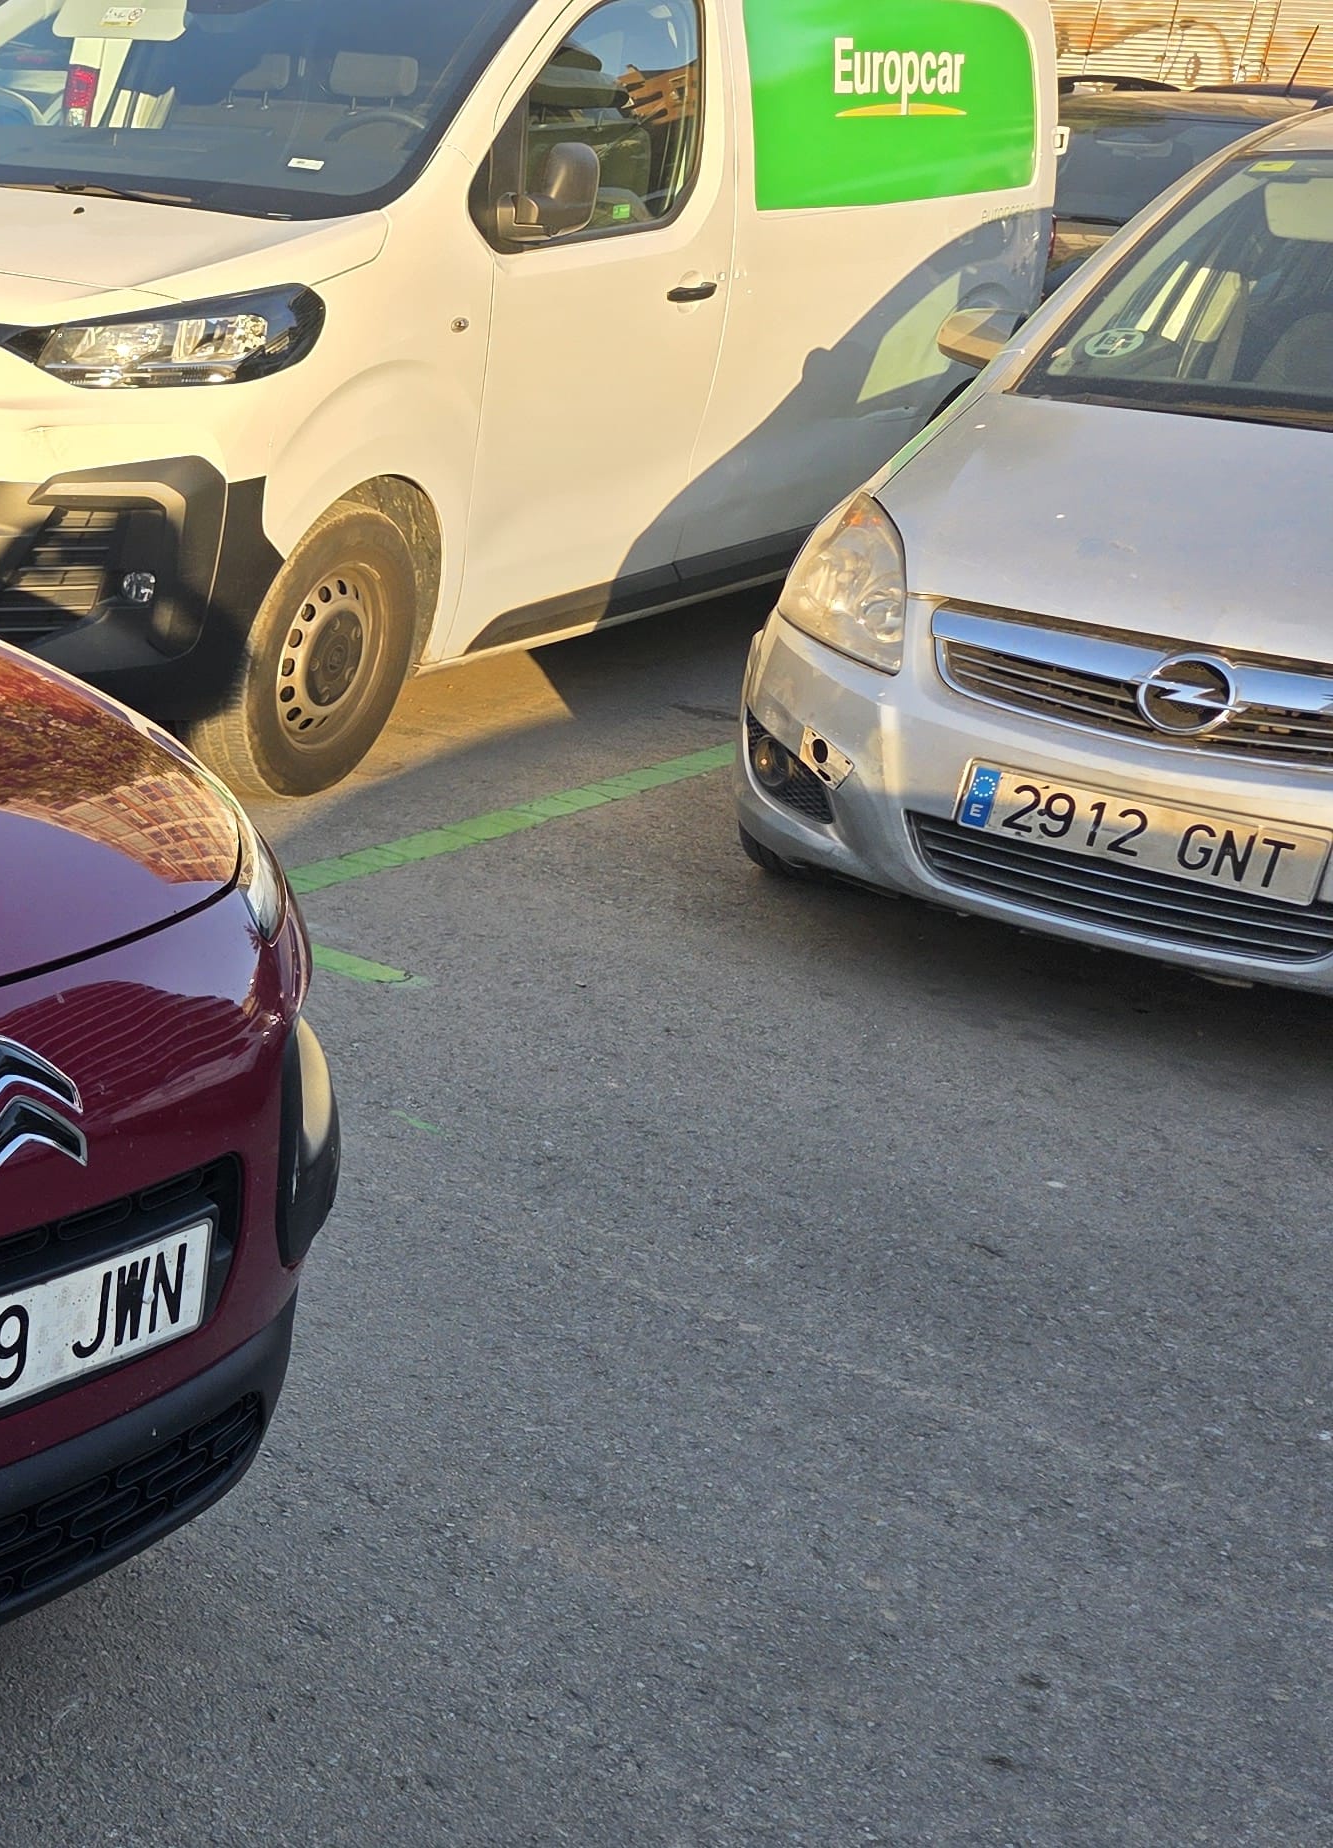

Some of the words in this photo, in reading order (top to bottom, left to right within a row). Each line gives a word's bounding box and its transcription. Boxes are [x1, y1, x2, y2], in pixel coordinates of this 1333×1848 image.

[834, 37, 965, 115] Europcar
[969, 803, 985, 818] E
[1001, 784, 1148, 857] 2912
[1176, 823, 1297, 888] GNT
[72, 1242, 188, 1359] JWN
